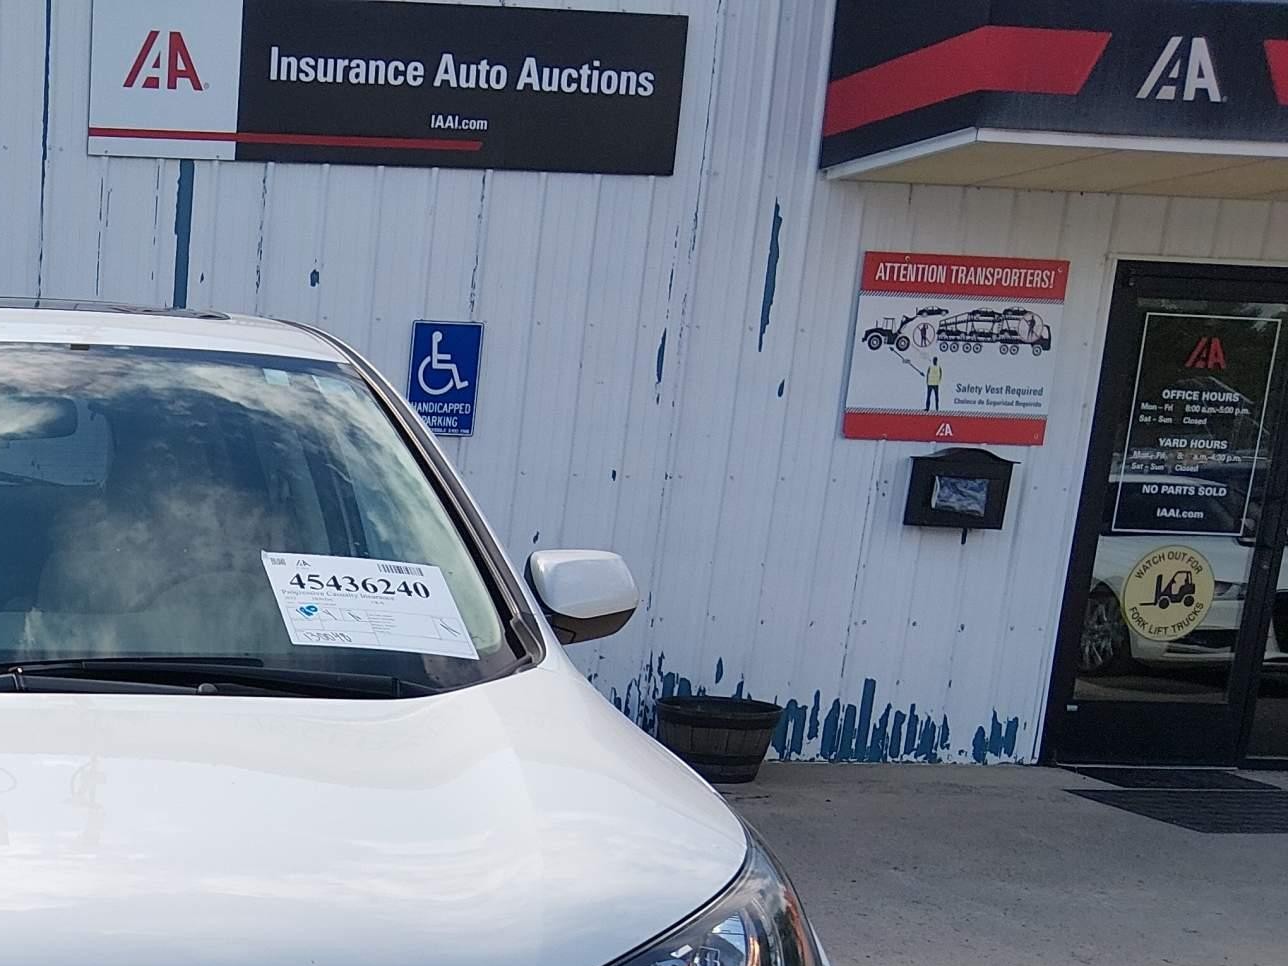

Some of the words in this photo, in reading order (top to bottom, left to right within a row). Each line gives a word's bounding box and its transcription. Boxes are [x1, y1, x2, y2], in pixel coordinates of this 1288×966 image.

[269, 46, 425, 86] Insurance
[433, 53, 508, 90] Auto
[516, 57, 655, 96] Auctions
[430, 114, 488, 130] IAAI.com
[875, 262, 947, 284] ATTENTION
[950, 265, 1055, 289] TRANSPORTERS!
[956, 383, 982, 395] Safety
[985, 384, 1003, 394] Vest
[1005, 385, 1044, 397] Required
[1162, 389, 1200, 400] OFFICE
[1202, 391, 1240, 402] HOURS
[411, 402, 471, 414] HANDICAPPED
[1141, 403, 1157, 411] Mon
[422, 416, 458, 428] PARKING
[1139, 414, 1151, 422] Sat
[1158, 416, 1172, 424] Sun
[1183, 417, 1207, 425] Closed
[1158, 438, 1187, 448] YARD
[1190, 440, 1228, 450] HOURS
[1175, 464, 1199, 472] Closed
[1142, 484, 1158, 494] NO
[1161, 485, 1195, 496] PARTS
[1198, 487, 1227, 497] SOLD
[1135, 552, 1165, 580] WATCH
[1167, 551, 1188, 561] OUT
[1185, 556, 1203, 575] FOR
[289, 572, 430, 599] 45436240
[1129, 606, 1148, 630] FORK
[1148, 624, 1169, 635] LIFT
[1171, 602, 1204, 634] TRUCKS
